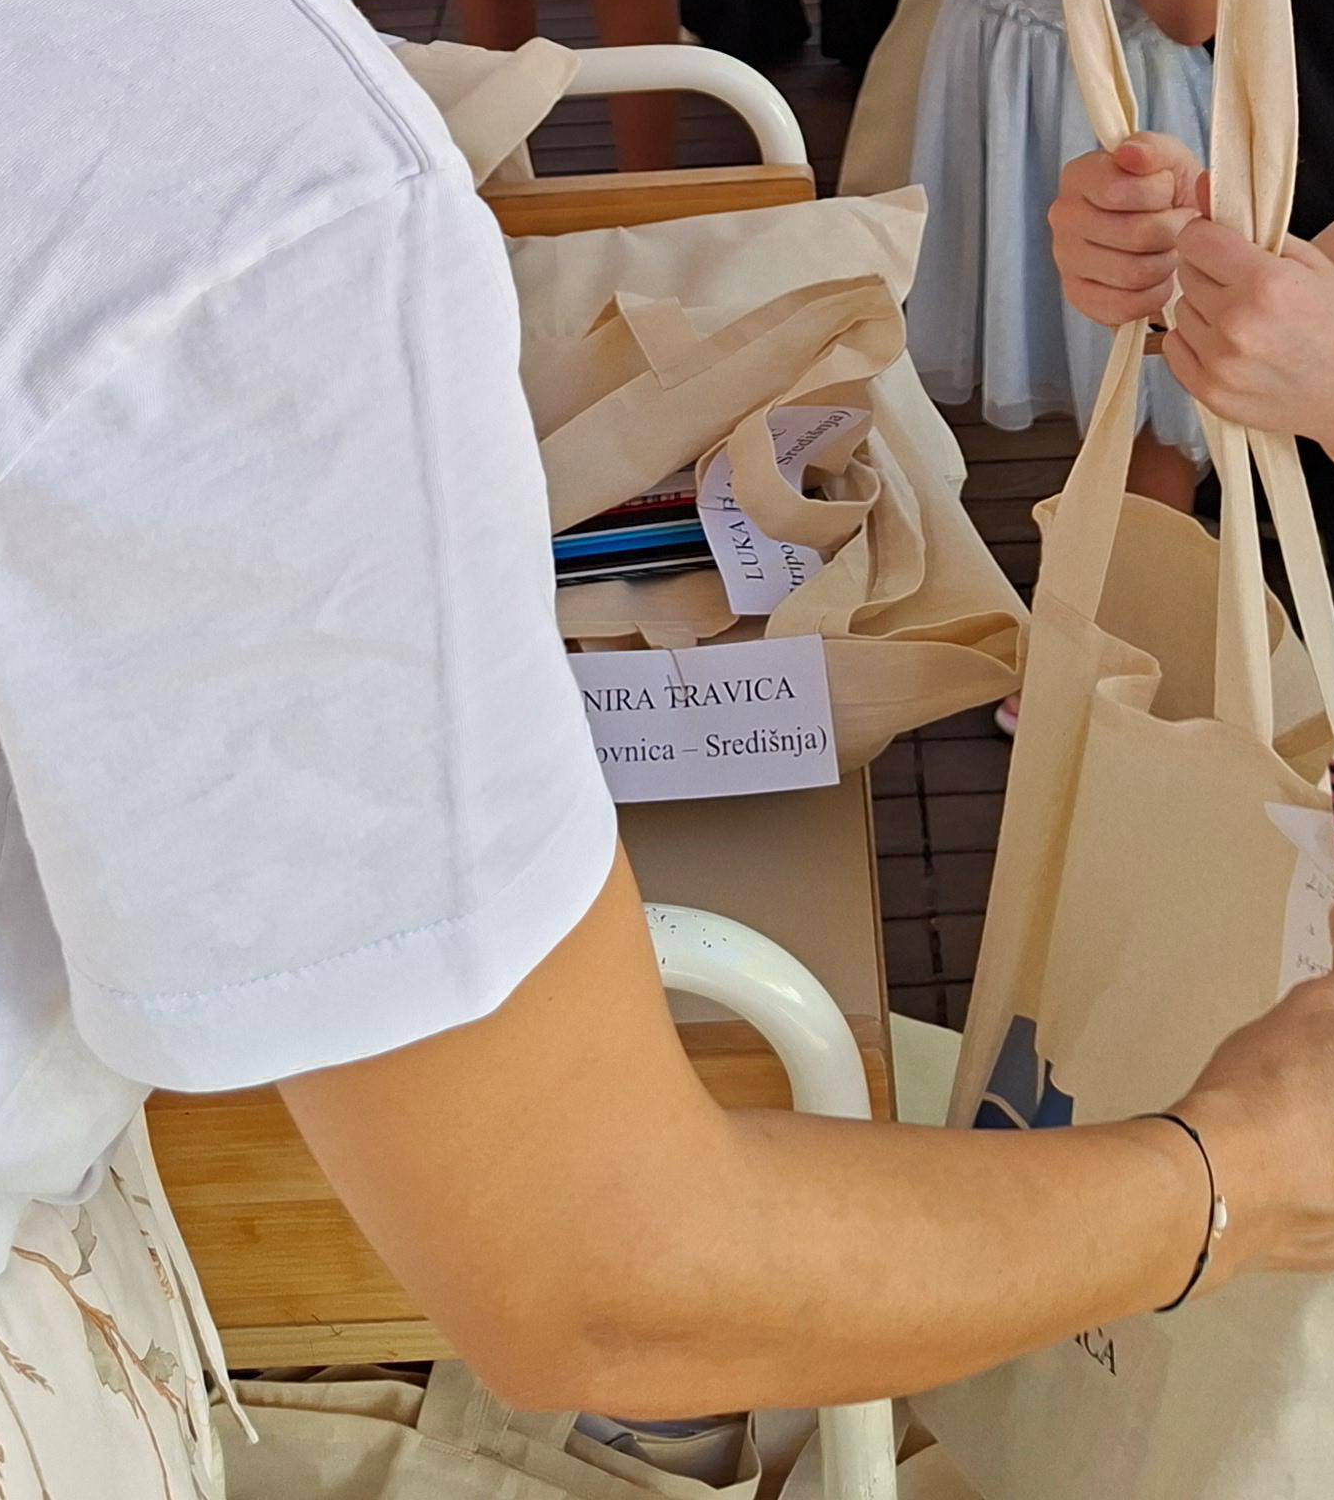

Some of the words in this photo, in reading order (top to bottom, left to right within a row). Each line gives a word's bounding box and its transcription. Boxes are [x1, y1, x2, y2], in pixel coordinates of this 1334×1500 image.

[728, 520, 765, 581] LUKA
[779, 543, 806, 593] tripo
[664, 676, 797, 710] TRAVICA
[706, 725, 828, 759] Središnja)
